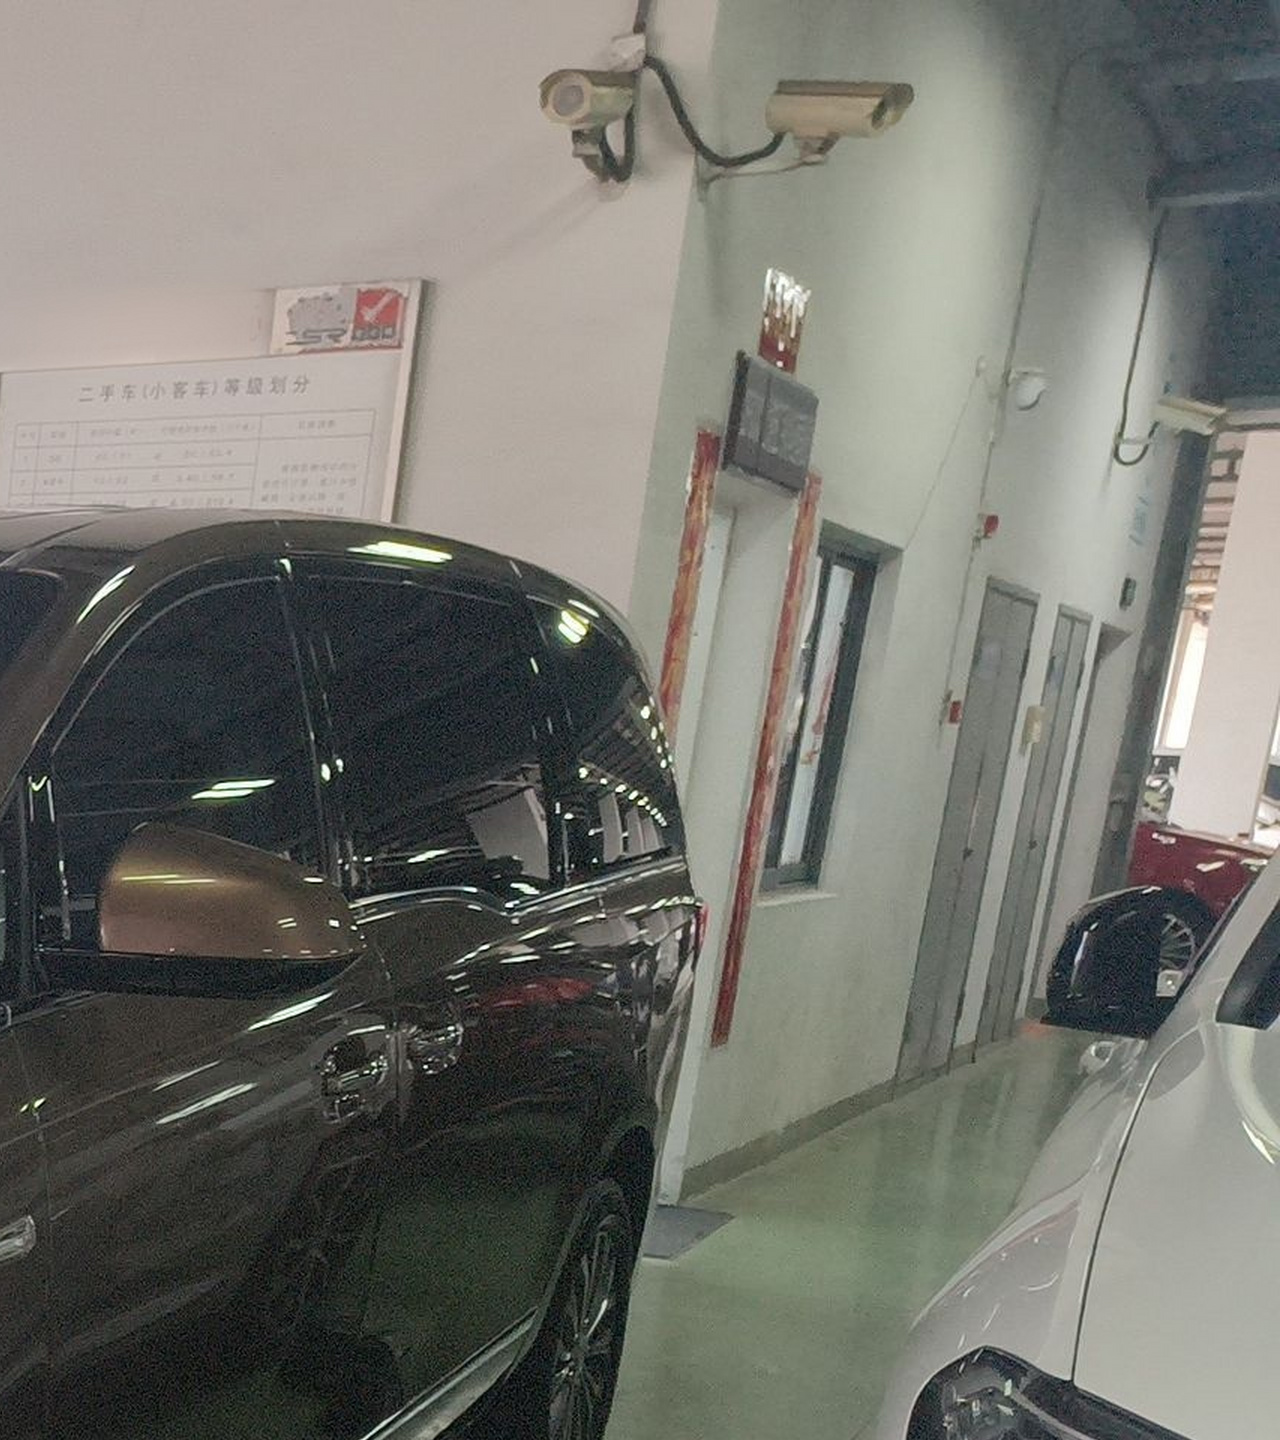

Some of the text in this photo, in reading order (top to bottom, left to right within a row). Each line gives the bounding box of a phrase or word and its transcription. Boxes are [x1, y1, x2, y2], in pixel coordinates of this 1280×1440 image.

[79, 374, 311, 403] 二手车(小客车)等级划分
